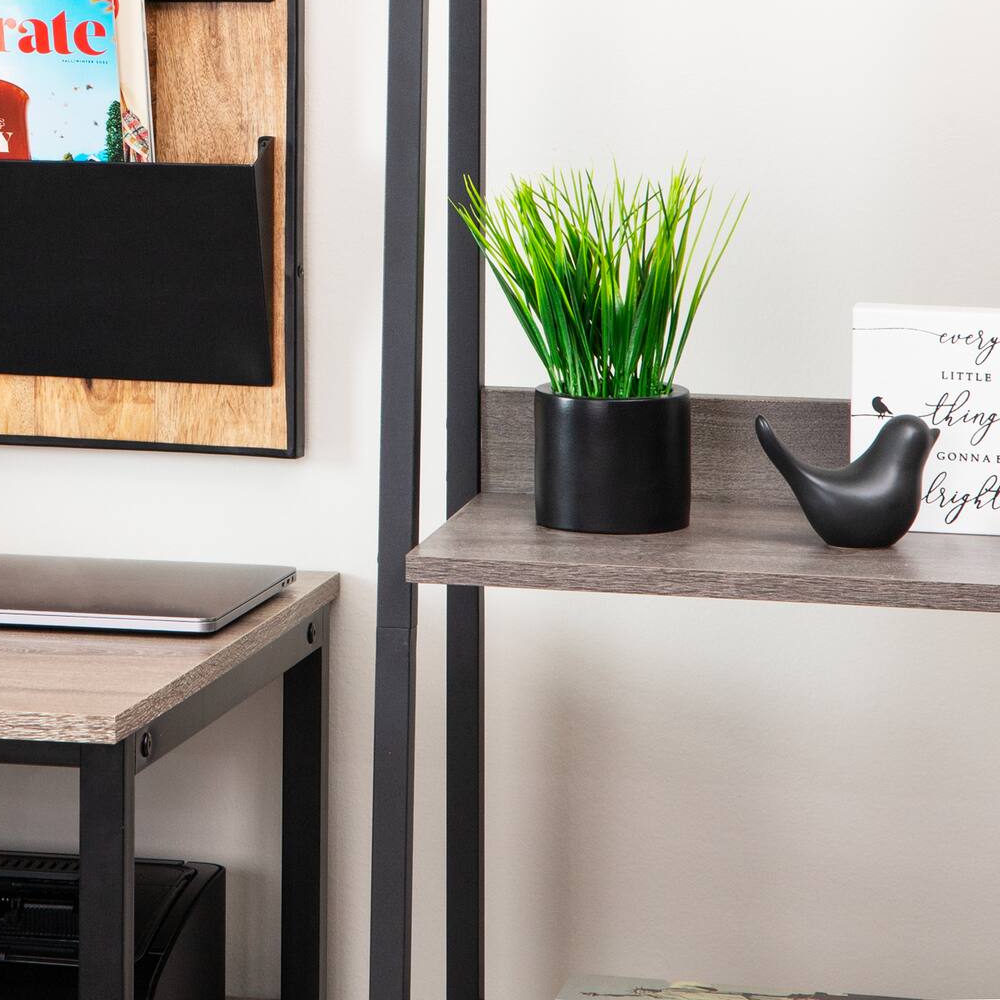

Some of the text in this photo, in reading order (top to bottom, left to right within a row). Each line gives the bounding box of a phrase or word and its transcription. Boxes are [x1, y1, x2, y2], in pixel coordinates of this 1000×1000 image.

[939, 329, 1000, 366] every
[941, 370, 992, 382] LITTLE
[925, 389, 1000, 447] thing
[936, 451, 991, 464] GONNA
